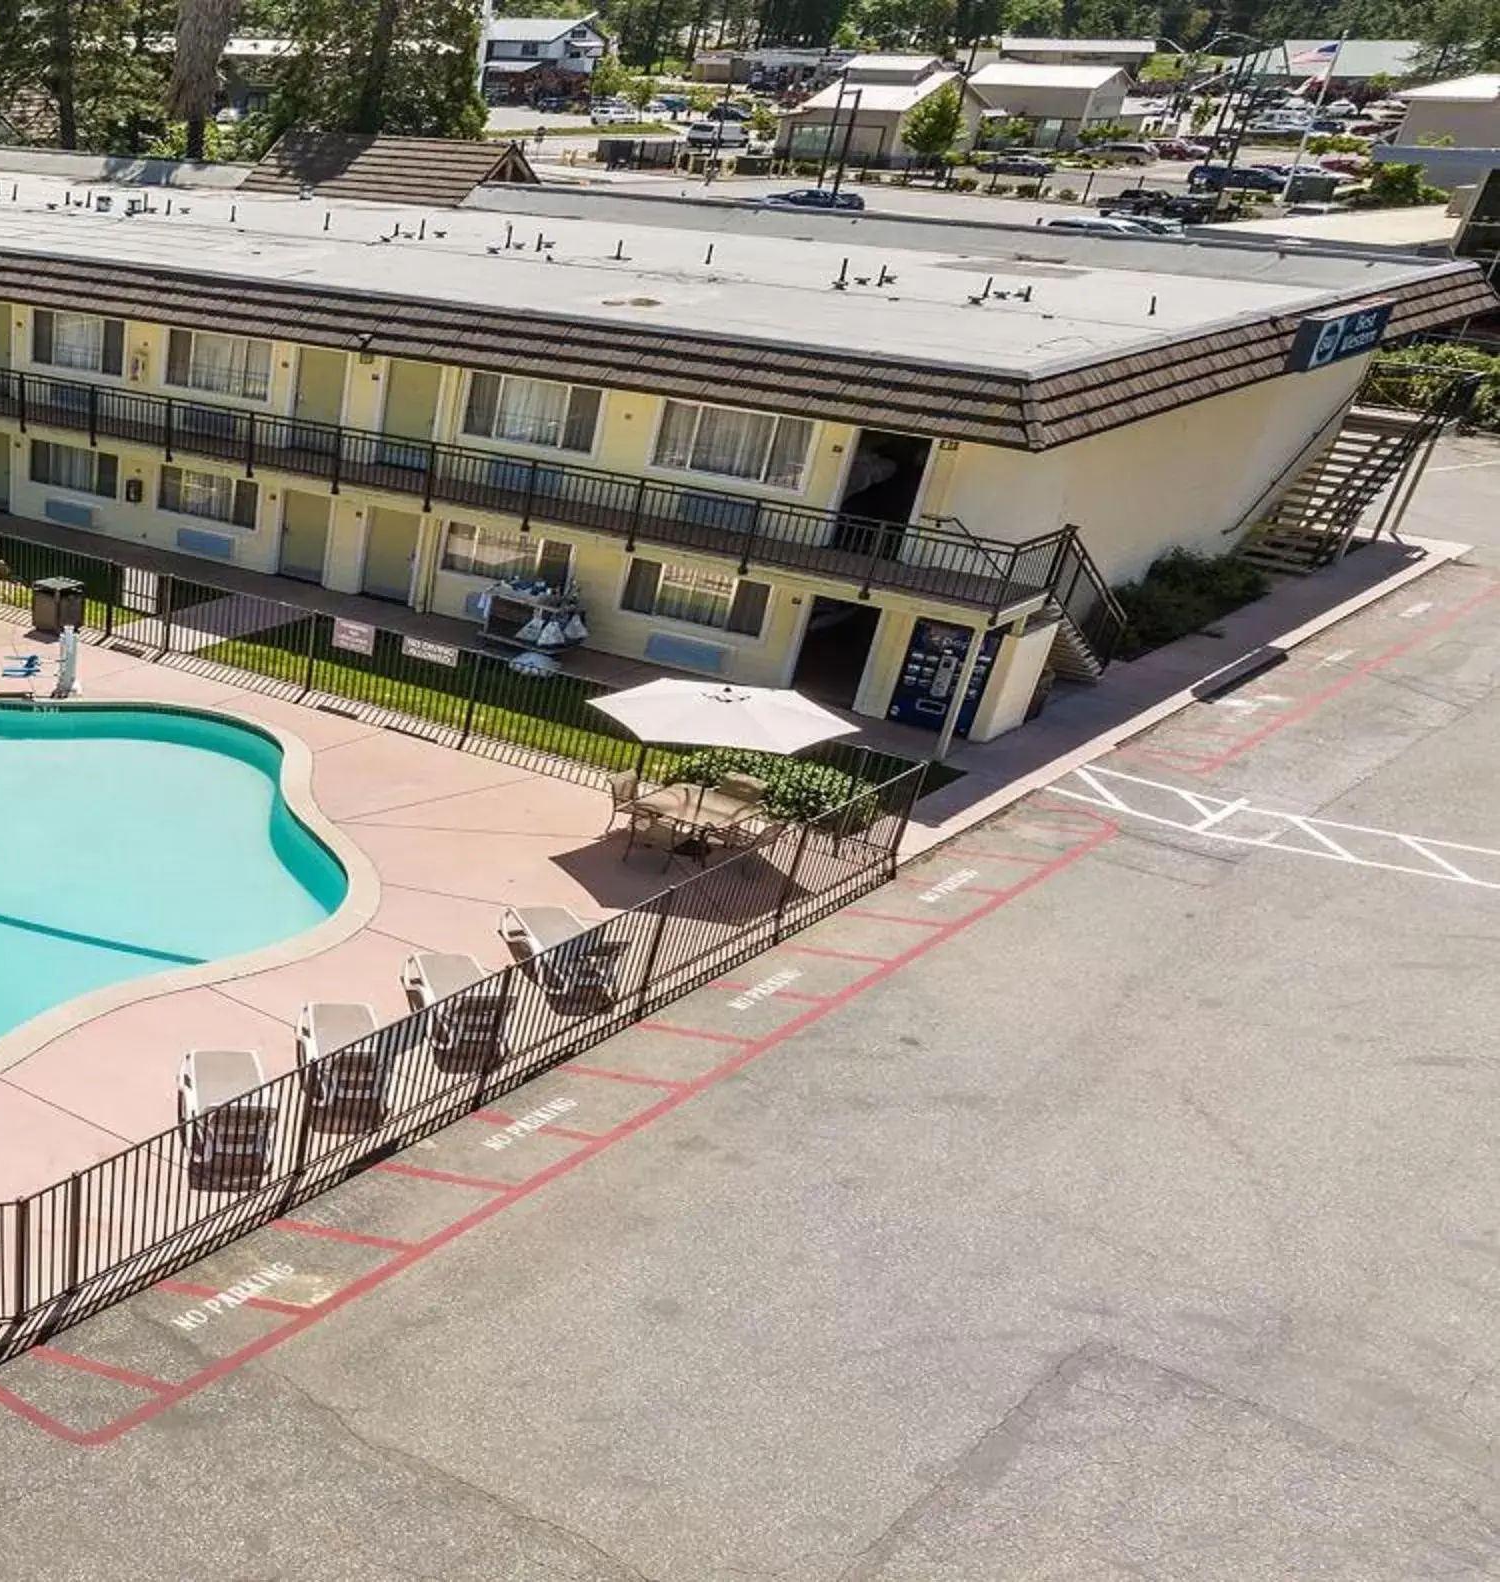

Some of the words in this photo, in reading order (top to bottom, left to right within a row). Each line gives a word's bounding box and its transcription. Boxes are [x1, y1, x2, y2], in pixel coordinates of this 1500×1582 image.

[1341, 330, 1378, 351] Western
[1356, 311, 1379, 332] Best
[726, 995, 756, 1011] NO
[743, 967, 804, 1001] PARKING
[481, 1133, 513, 1152] NO
[504, 1097, 580, 1137] PARKING
[171, 1308, 209, 1331] NO
[203, 1261, 295, 1314] PARKING
